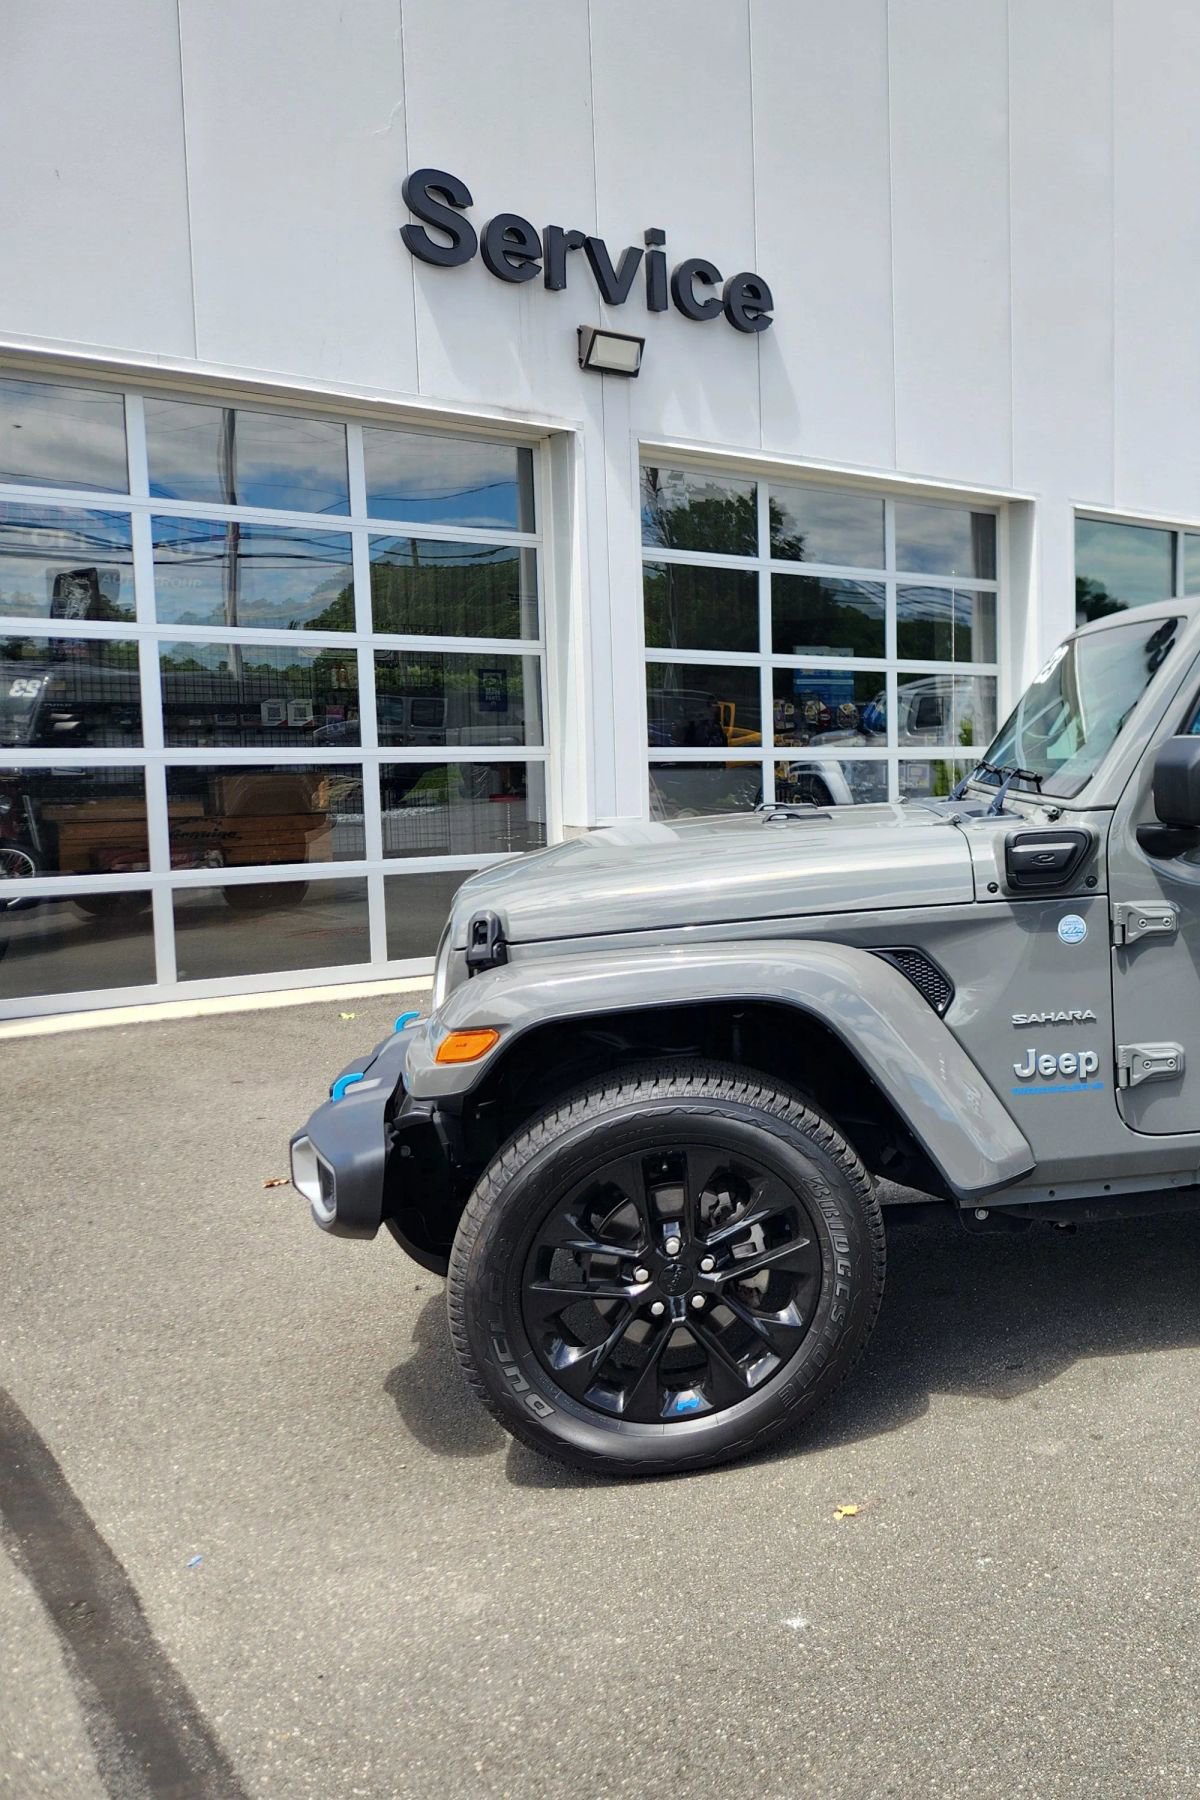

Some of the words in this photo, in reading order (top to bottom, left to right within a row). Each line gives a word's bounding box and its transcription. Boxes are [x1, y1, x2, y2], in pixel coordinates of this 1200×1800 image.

[400, 168, 774, 334] Service
[1011, 1009, 1097, 1025] SAHARA
[1013, 1049, 1100, 1079] Jeep
[778, 1174, 852, 1410] BRIDGESTONE
